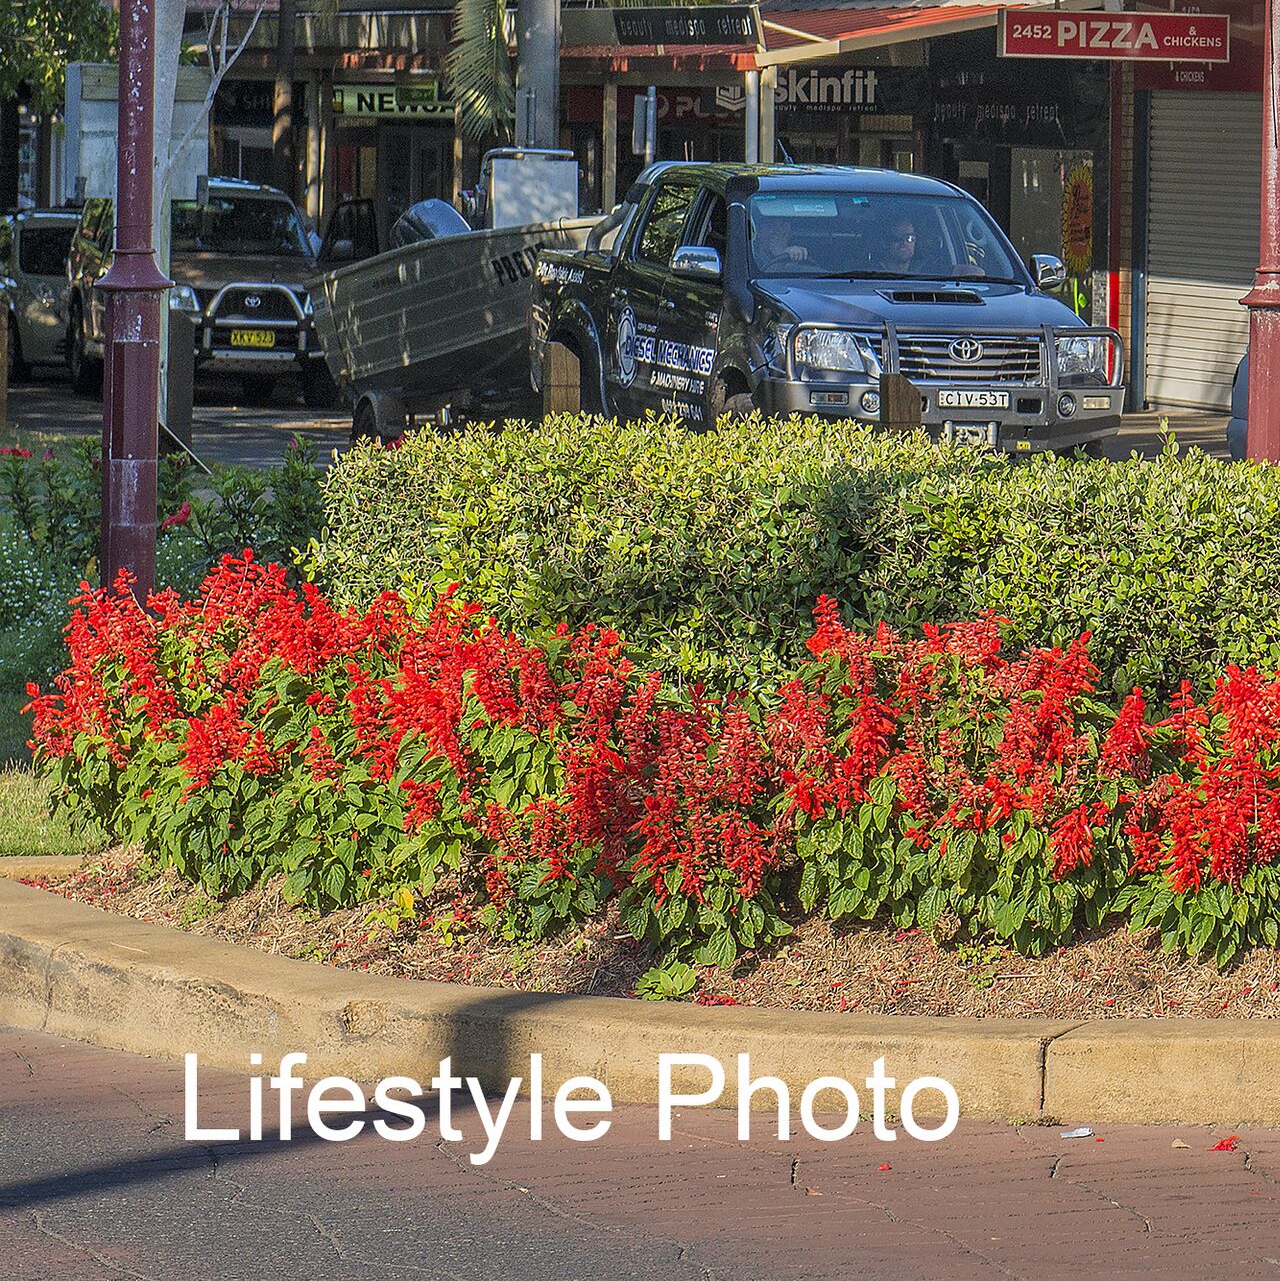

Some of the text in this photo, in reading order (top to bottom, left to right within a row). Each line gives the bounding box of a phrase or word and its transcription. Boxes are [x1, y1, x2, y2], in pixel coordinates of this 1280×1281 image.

[716, 14, 753, 36] retreat
[1012, 20, 1159, 49] 2452 PIZZA
[1188, 25, 1197, 36] &
[1163, 36, 1222, 48] CHICKENS
[625, 335, 715, 376] DIESEL MECHANICS
